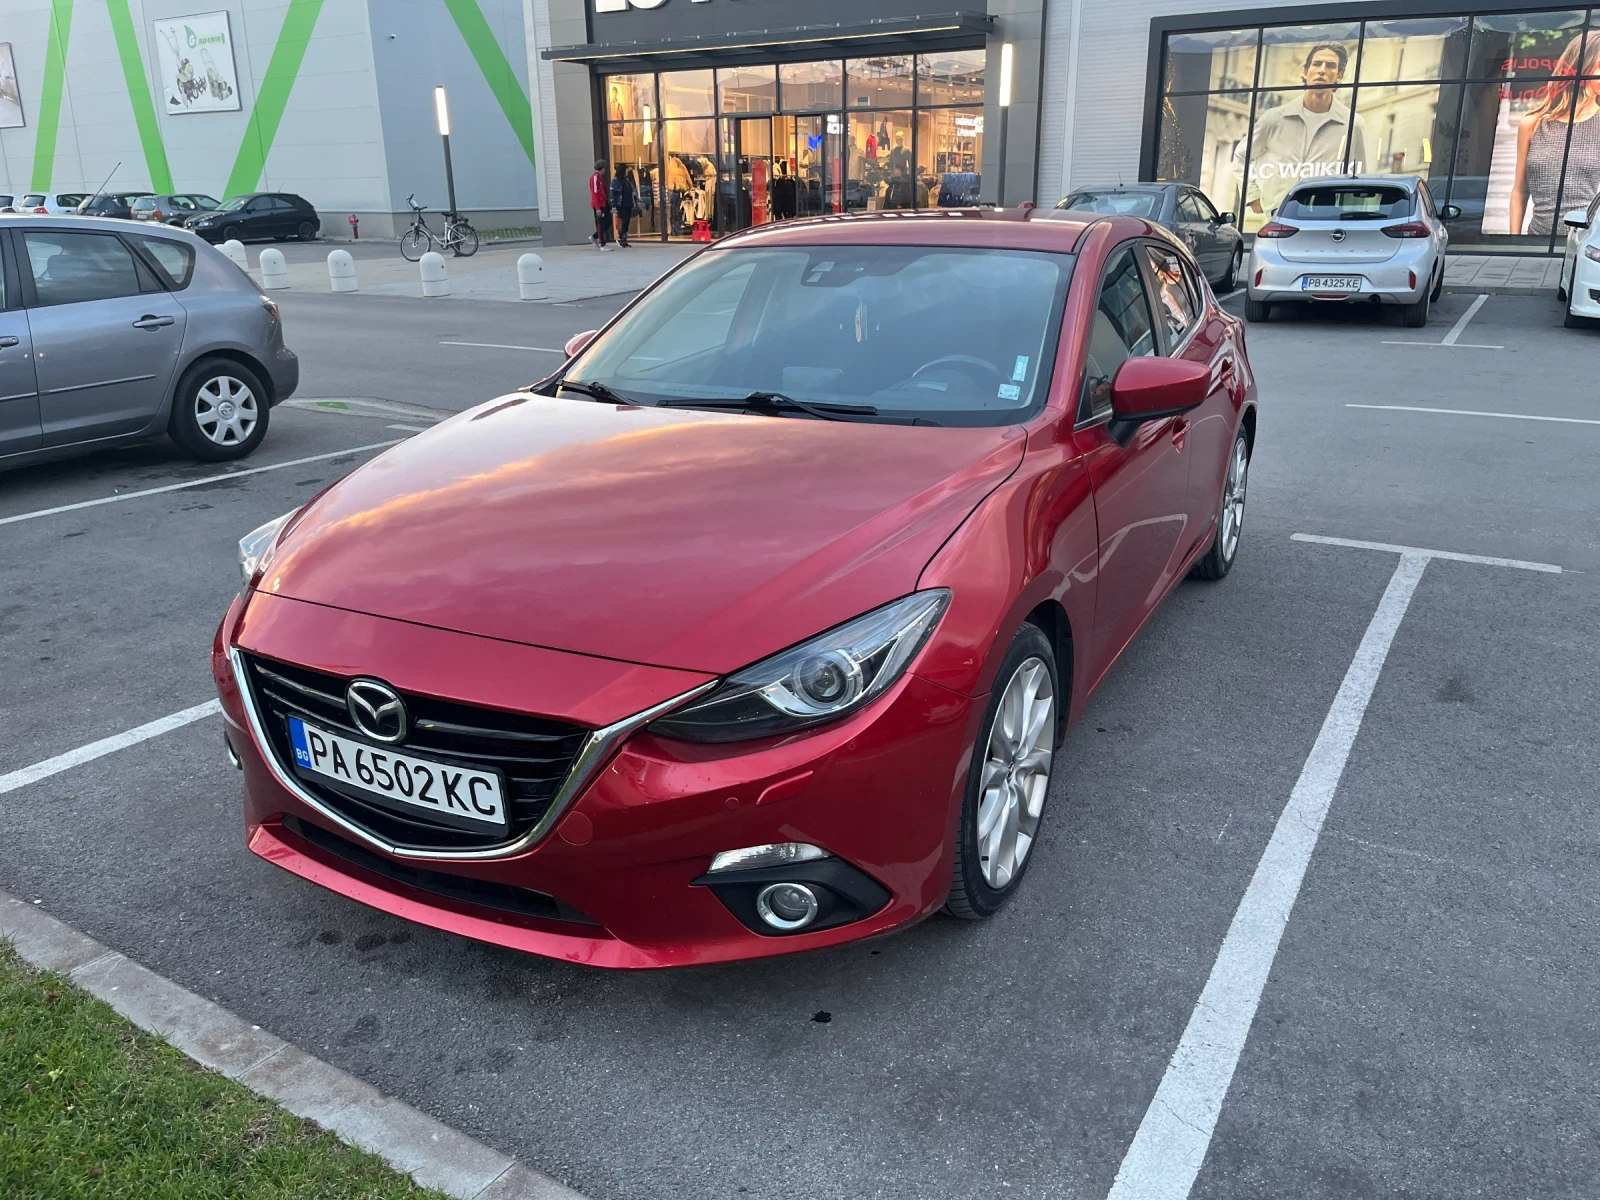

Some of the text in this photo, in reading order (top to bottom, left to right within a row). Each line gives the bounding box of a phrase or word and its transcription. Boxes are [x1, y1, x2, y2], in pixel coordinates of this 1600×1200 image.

[1248, 163, 1275, 181] LC
[1322, 278, 1345, 288] 4325
[1346, 279, 1359, 288] KE
[296, 747, 309, 762] BG
